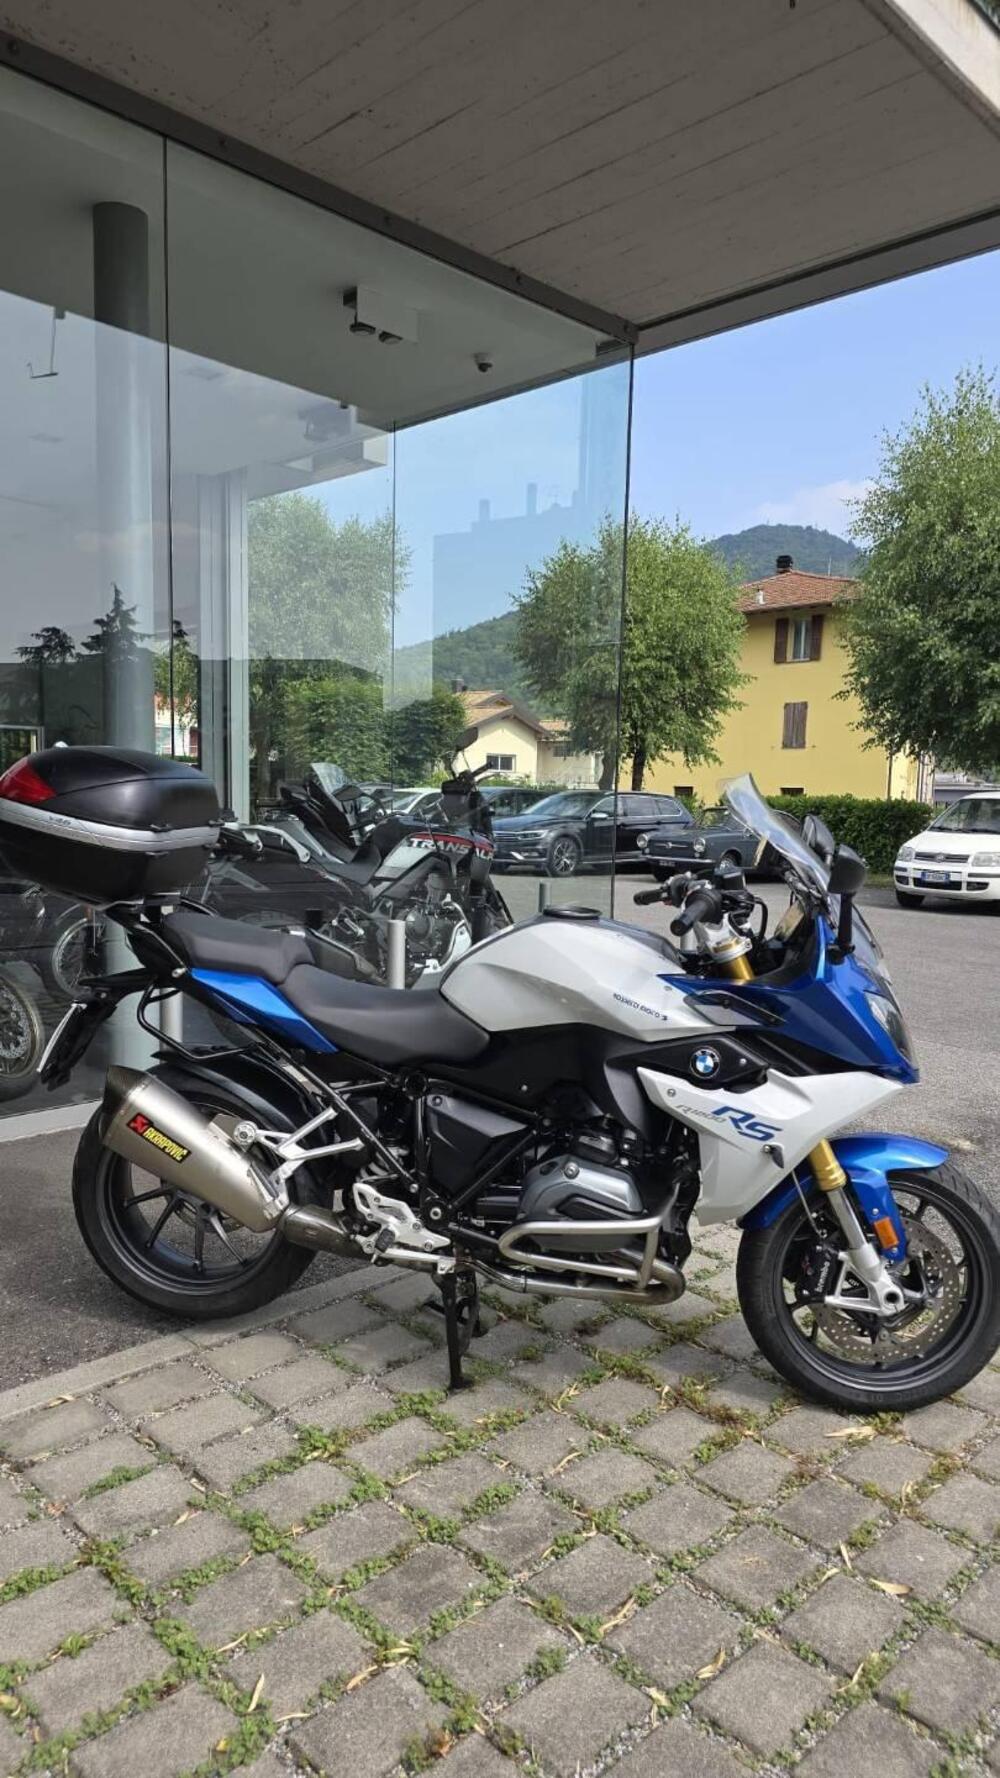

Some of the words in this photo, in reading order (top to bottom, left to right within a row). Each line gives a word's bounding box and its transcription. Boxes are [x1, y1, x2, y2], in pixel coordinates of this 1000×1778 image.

[410, 837, 494, 861] TRANSL
[711, 1105, 783, 1141] RS
[815, 1261, 831, 1293] brembo
